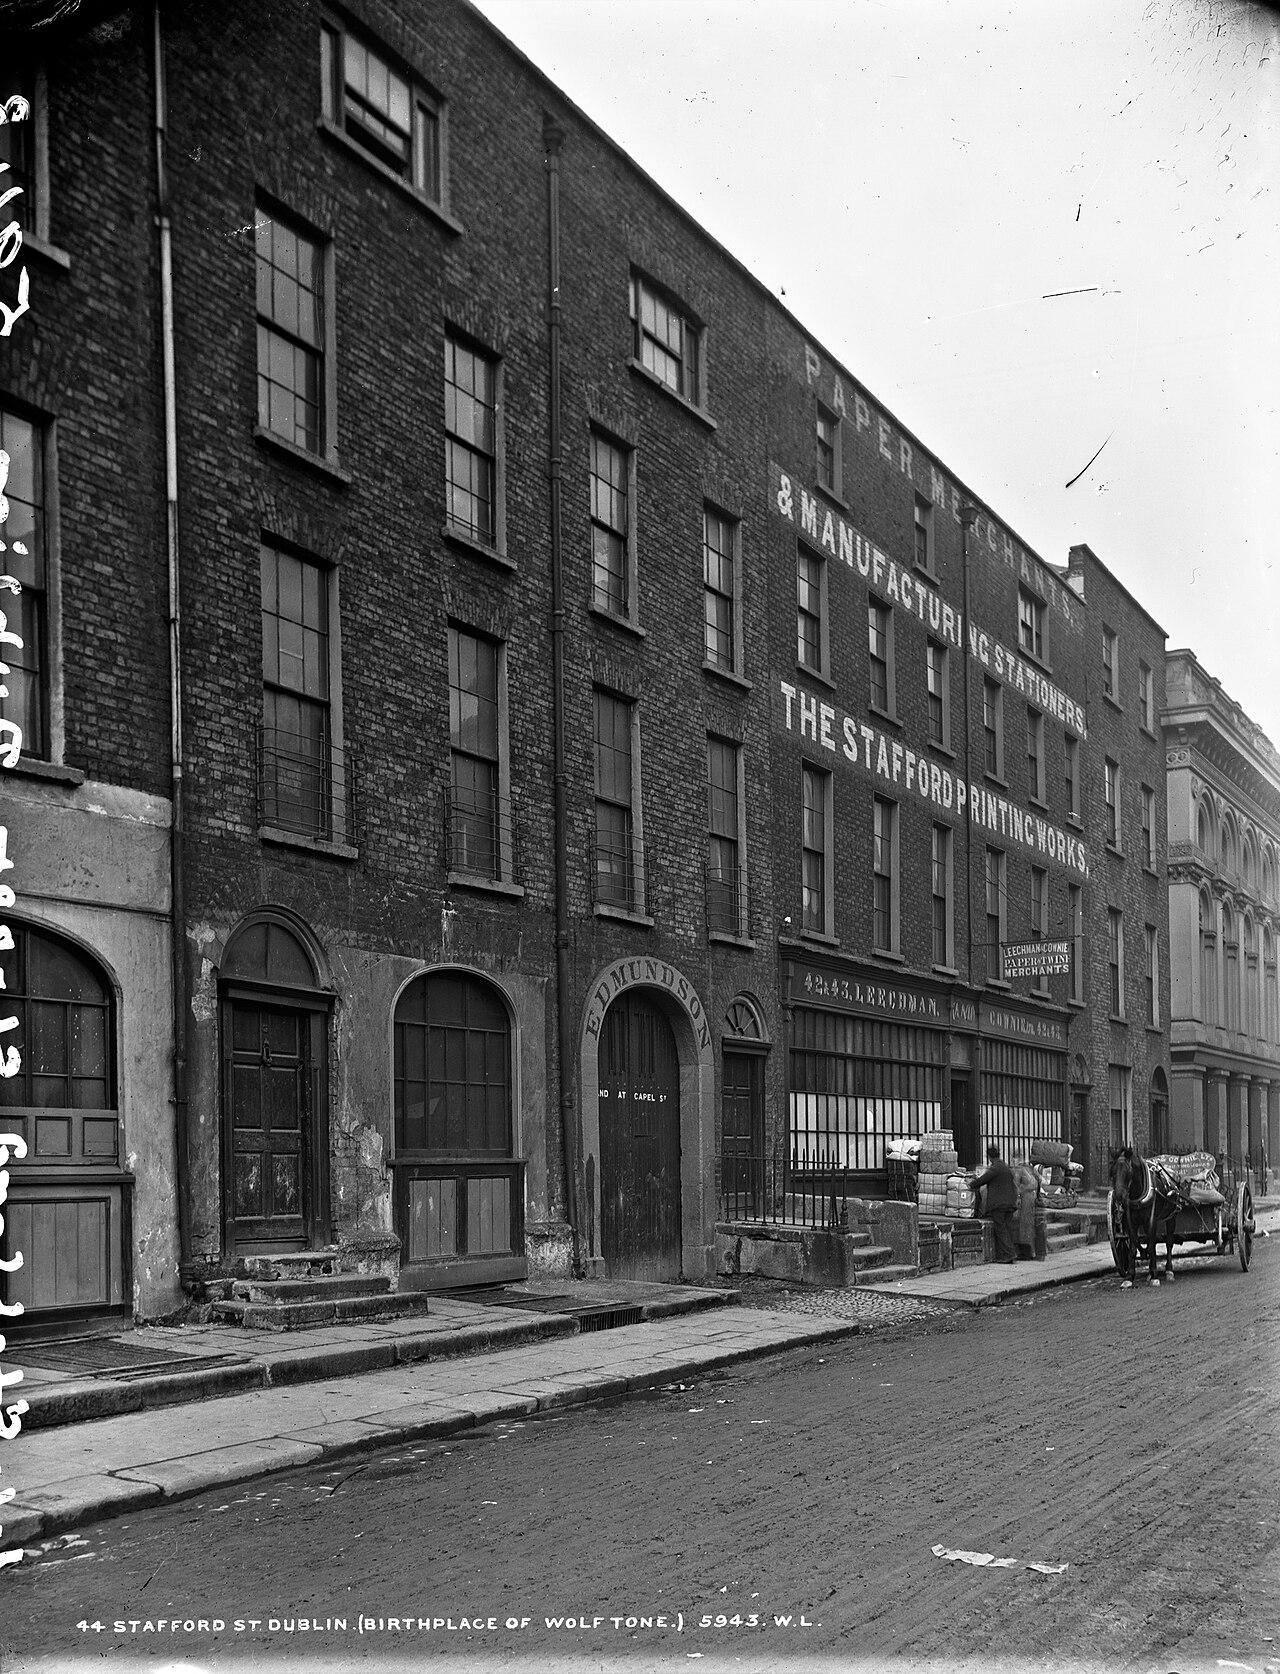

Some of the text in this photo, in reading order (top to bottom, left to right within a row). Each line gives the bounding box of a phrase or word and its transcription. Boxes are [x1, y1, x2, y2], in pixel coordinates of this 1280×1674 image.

[805, 344, 913, 480] PAPER
[777, 474, 1087, 740] & MANUFACTURING STATIONERS,
[780, 681, 1089, 879] THE STAFFORD PRINTING WORKS,
[585, 960, 711, 1050] EDMUNDSON
[1004, 957, 1037, 968] PAPER
[1042, 954, 1071, 965] TWINE
[1004, 964, 1069, 978] MERCHANTS
[617, 1091, 627, 1099] AT
[634, 1092, 656, 1102] CAPEL
